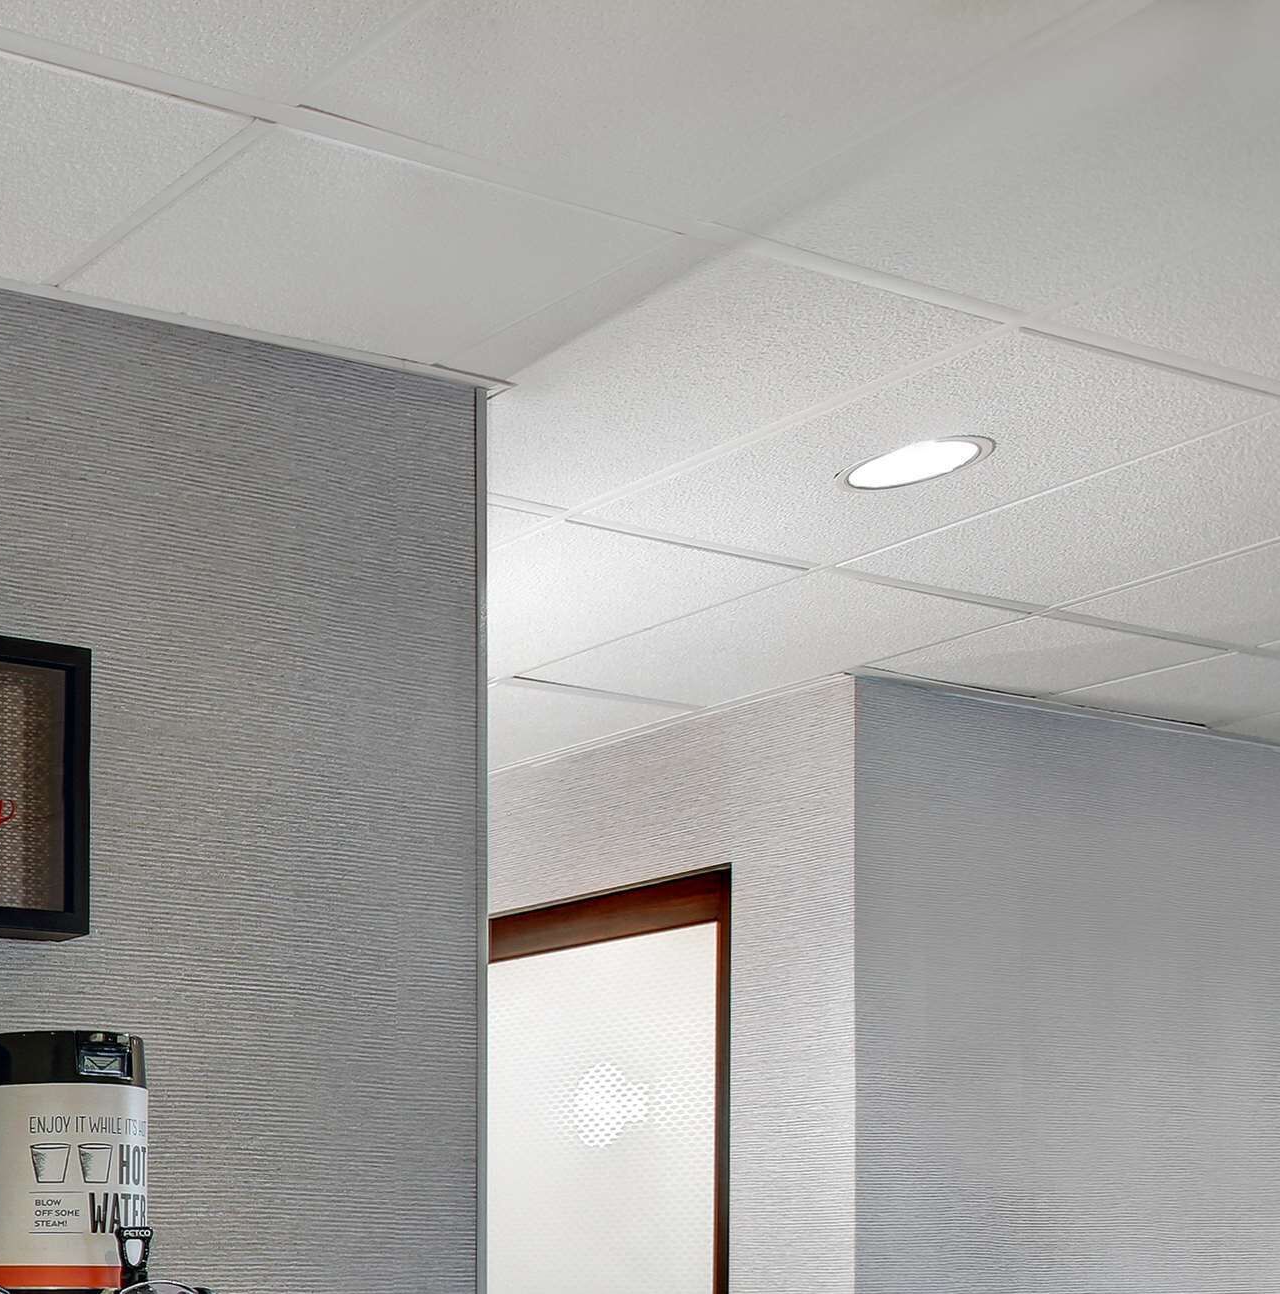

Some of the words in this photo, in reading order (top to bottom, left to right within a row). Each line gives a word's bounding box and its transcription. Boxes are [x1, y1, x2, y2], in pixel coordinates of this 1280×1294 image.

[30, 1116, 70, 1133] ENJOY
[75, 1116, 86, 1133] IT
[89, 1116, 121, 1134] WHILE
[119, 1144, 146, 1187] HOT
[89, 1192, 146, 1233] WATER
